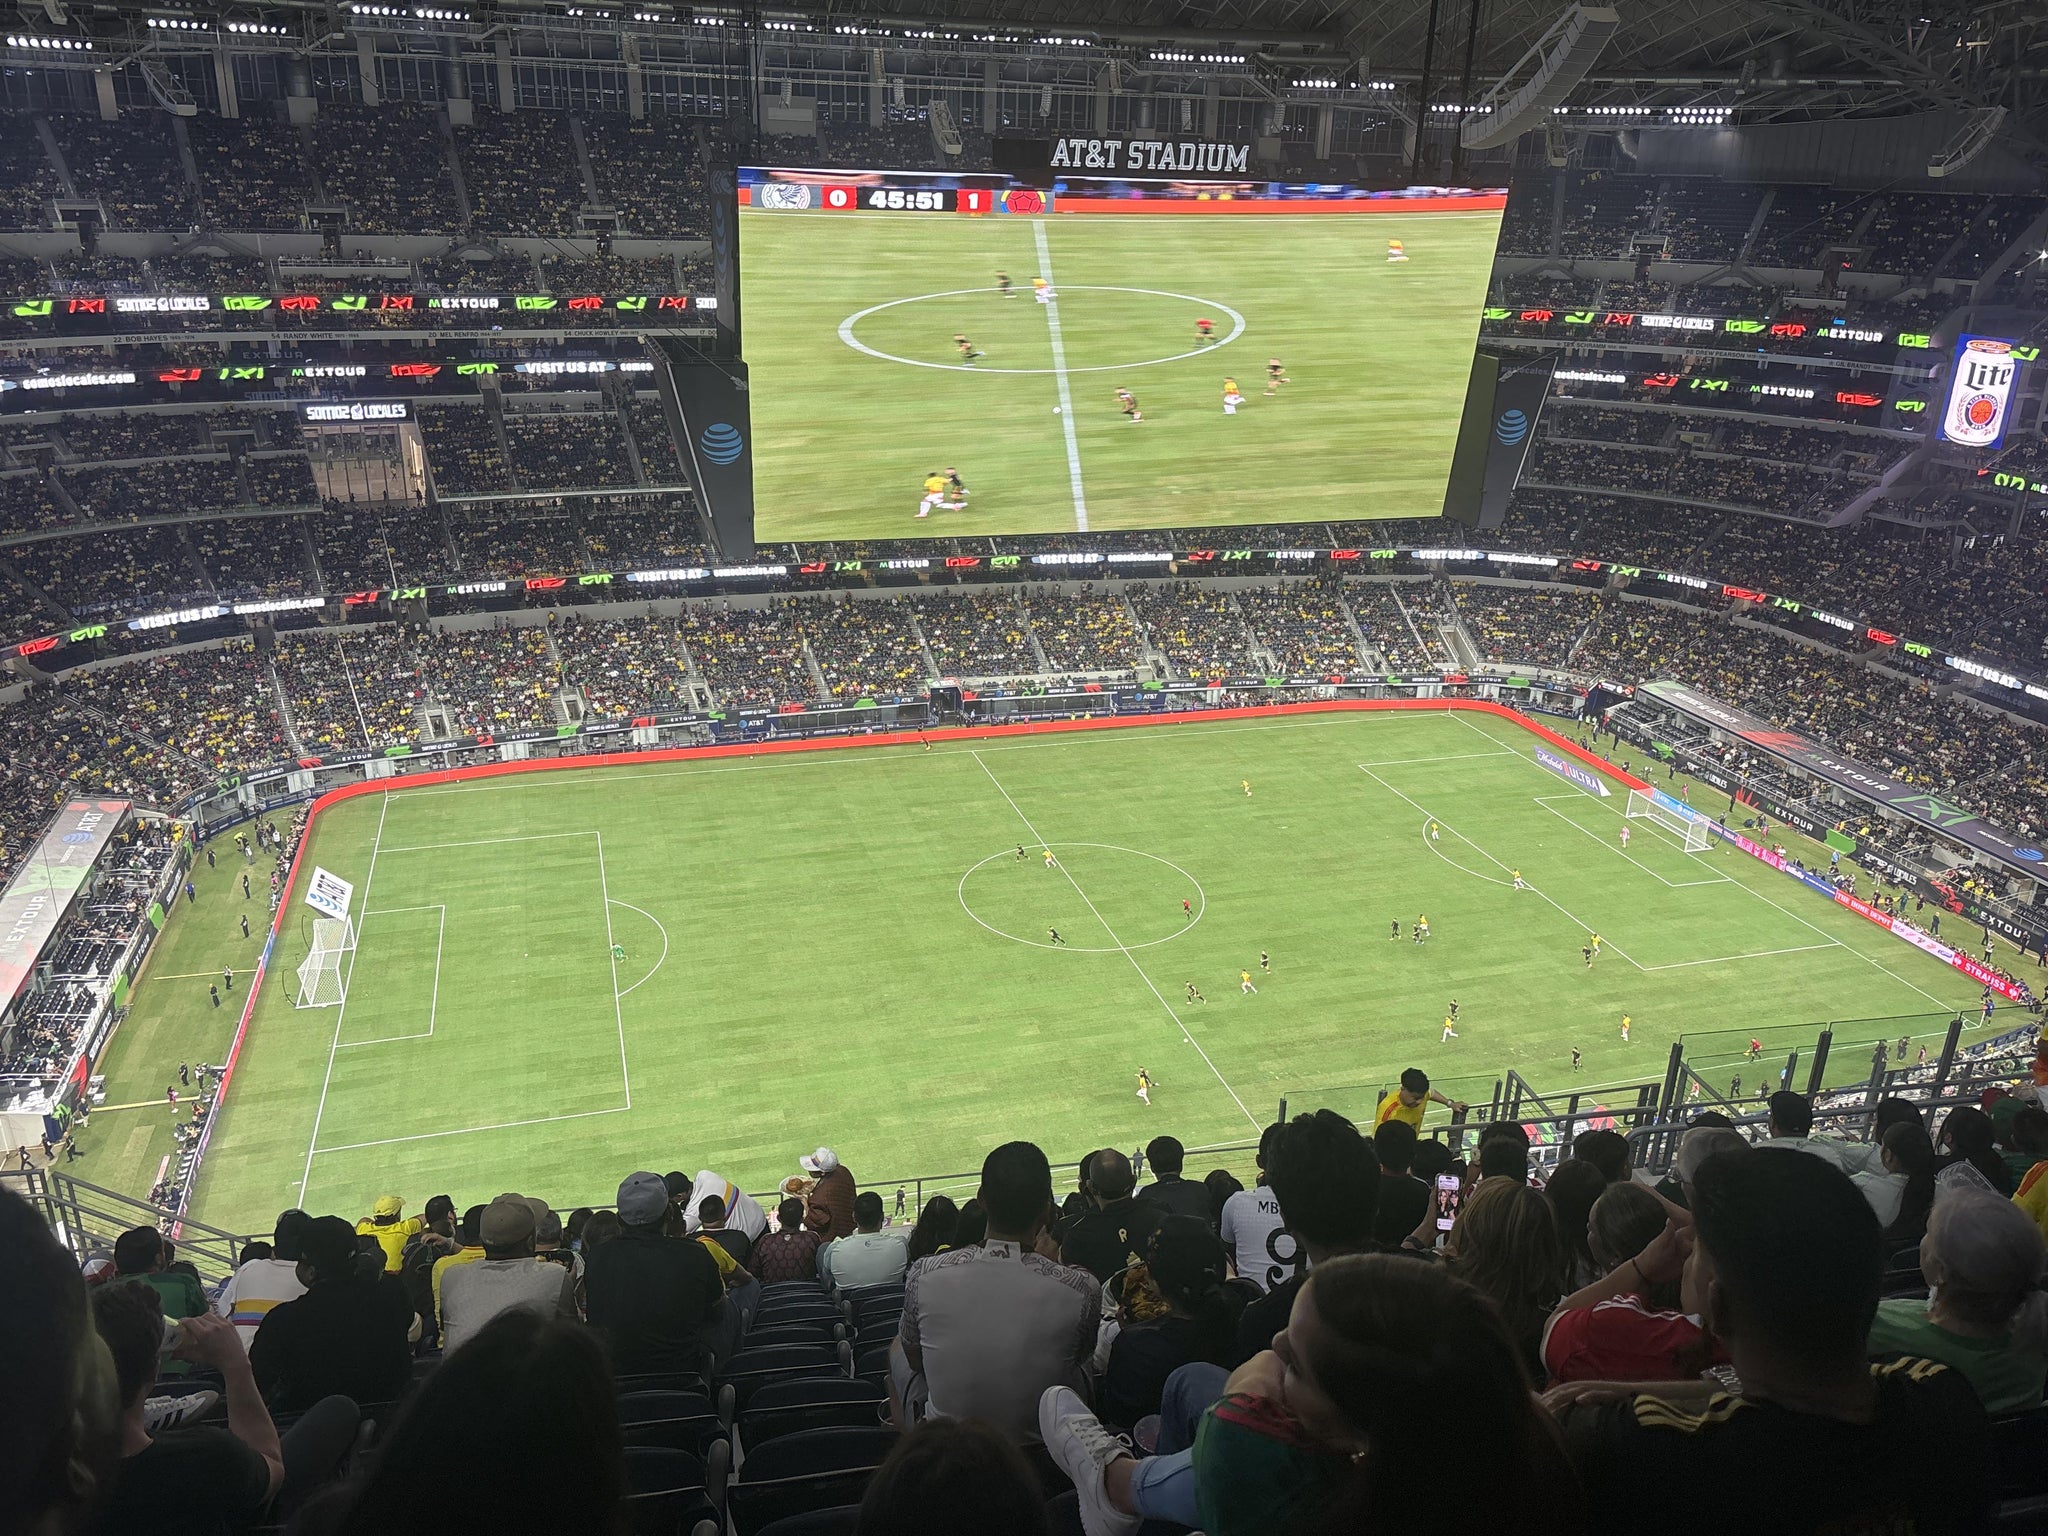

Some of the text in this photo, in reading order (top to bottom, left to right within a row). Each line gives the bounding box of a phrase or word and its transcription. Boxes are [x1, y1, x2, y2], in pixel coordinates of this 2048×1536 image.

[1050, 139, 1249, 172] AT&T STADIUM
[829, 189, 978, 209] 0 45:51 1
[169, 297, 210, 310] LOCALES
[428, 298, 499, 309] MEXTOUR
[1682, 317, 1714, 330] LOCALES
[125, 335, 142, 343] BOB
[1817, 328, 1883, 343] MEXTOUR
[1716, 350, 1745, 358] PEARSON
[292, 366, 366, 377] MEXTOUR
[525, 361, 607, 374] VISIT US AT
[23, 373, 136, 390] somoslocales.com
[1964, 361, 2011, 391] Lite
[1750, 385, 1814, 399] MEXTOUR
[363, 404, 406, 418] LOCALES
[1039, 554, 1068, 564] VISIT
[1267, 551, 1315, 559] MEXTOUR
[1419, 550, 1449, 560] VISIT
[880, 560, 929, 568] MEXTOUR
[635, 570, 668, 582] VISIT
[669, 569, 687, 581] US
[1657, 574, 1707, 589] MEXTOUR
[447, 582, 506, 594] MEXTOUR
[234, 598, 325, 614] somoslocales.com
[139, 606, 220, 630] VISIT US AT
[1811, 611, 1854, 631] MEXTOUR
[1953, 656, 2016, 688] VISIT US AT
[506, 732, 540, 740] MEXTOUR
[335, 753, 372, 763] MEXTOUR
[1569, 766, 1600, 791] ULTRA
[1806, 754, 1890, 791] MEXTOUR
[194, 791, 207, 802] AT&T
[76, 811, 104, 832] AT&T
[1766, 802, 1814, 832] MEXTOUR
[1892, 865, 1918, 885] LOCALES
[1837, 893, 1892, 927] THE HOME DEPOT
[1969, 906, 2026, 940] MEXTOU
[130, 933, 150, 976] MEXTOUR
[1965, 962, 2006, 991] STRAUSS
[1266, 1227, 1307, 1287] 9
